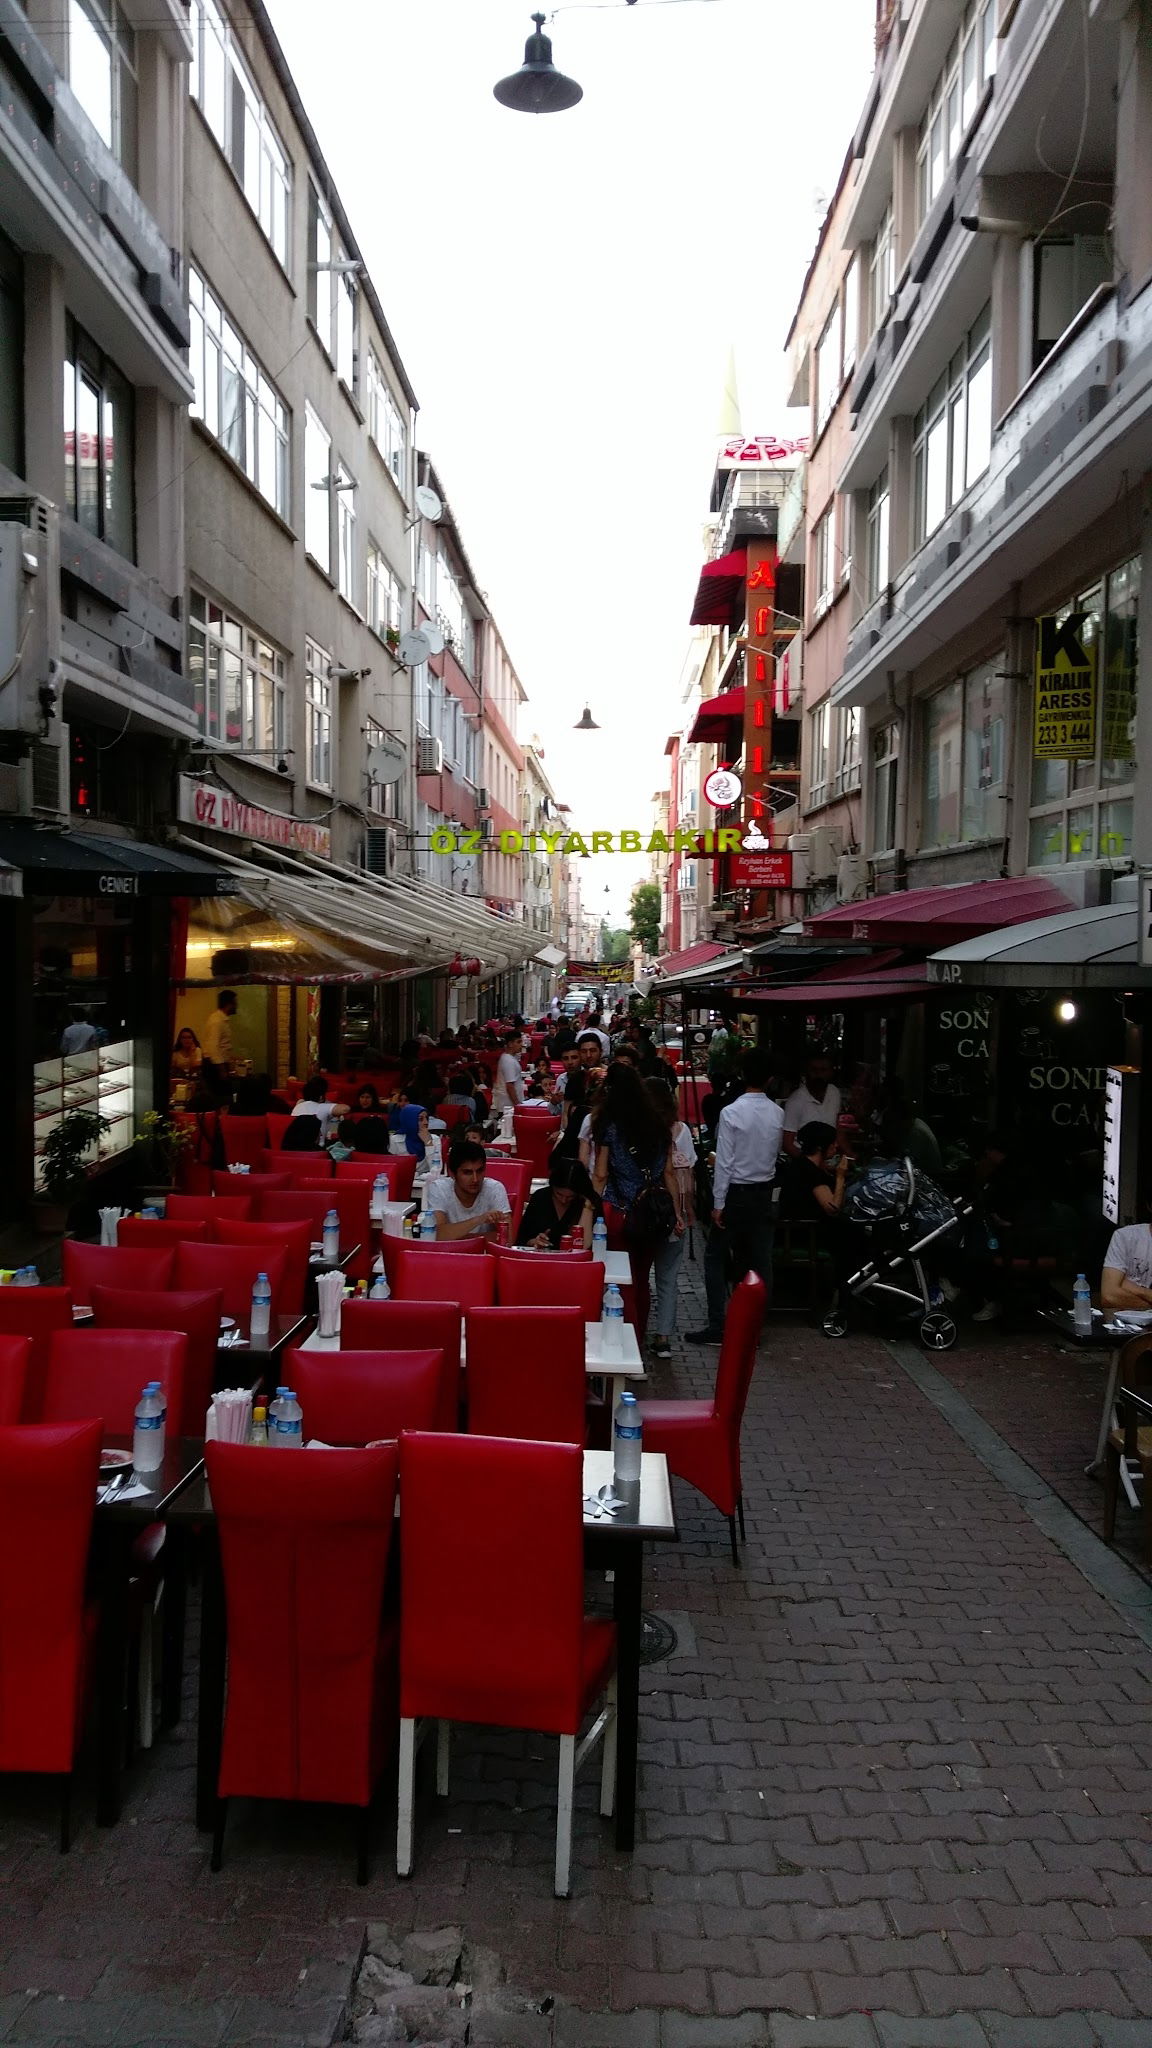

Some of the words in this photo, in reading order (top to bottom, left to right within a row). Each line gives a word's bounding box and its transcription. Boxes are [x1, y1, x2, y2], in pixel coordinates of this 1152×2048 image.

[1041, 611, 1092, 669] K
[1039, 692, 1092, 710] ARESS
[1038, 725, 1057, 745] 233
[1061, 724, 1067, 744] 3
[1070, 723, 1090, 742] 444
[430, 826, 482, 854] ÖZ
[500, 829, 743, 854] DİYARBAKIR
[943, 964, 962, 983] AP.
